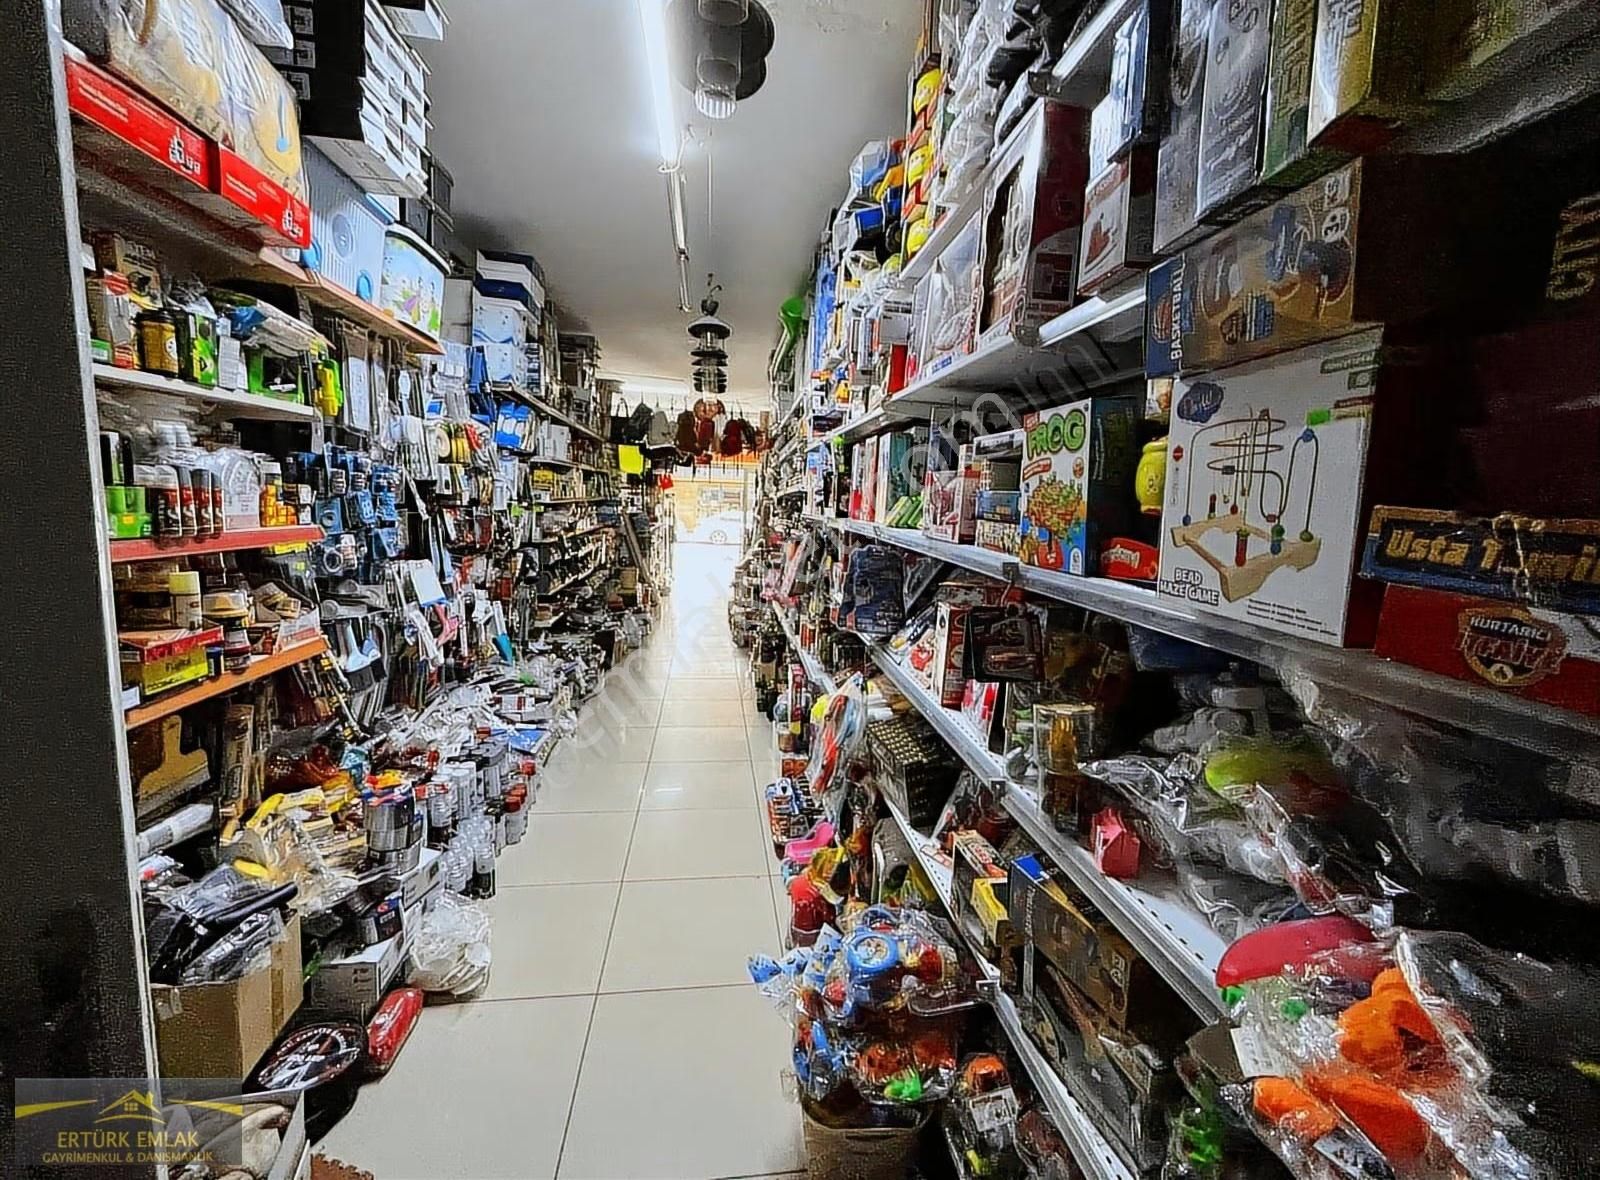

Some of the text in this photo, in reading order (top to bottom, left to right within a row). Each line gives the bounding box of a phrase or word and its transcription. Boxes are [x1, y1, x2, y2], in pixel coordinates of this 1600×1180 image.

[1170, 253, 1186, 361] BASKETBALL
[1027, 408, 1086, 460] FROG
[1386, 529, 1470, 567] Usta
[1159, 579, 1220, 607] MAZE GAME
[1174, 567, 1203, 585] BEAD
